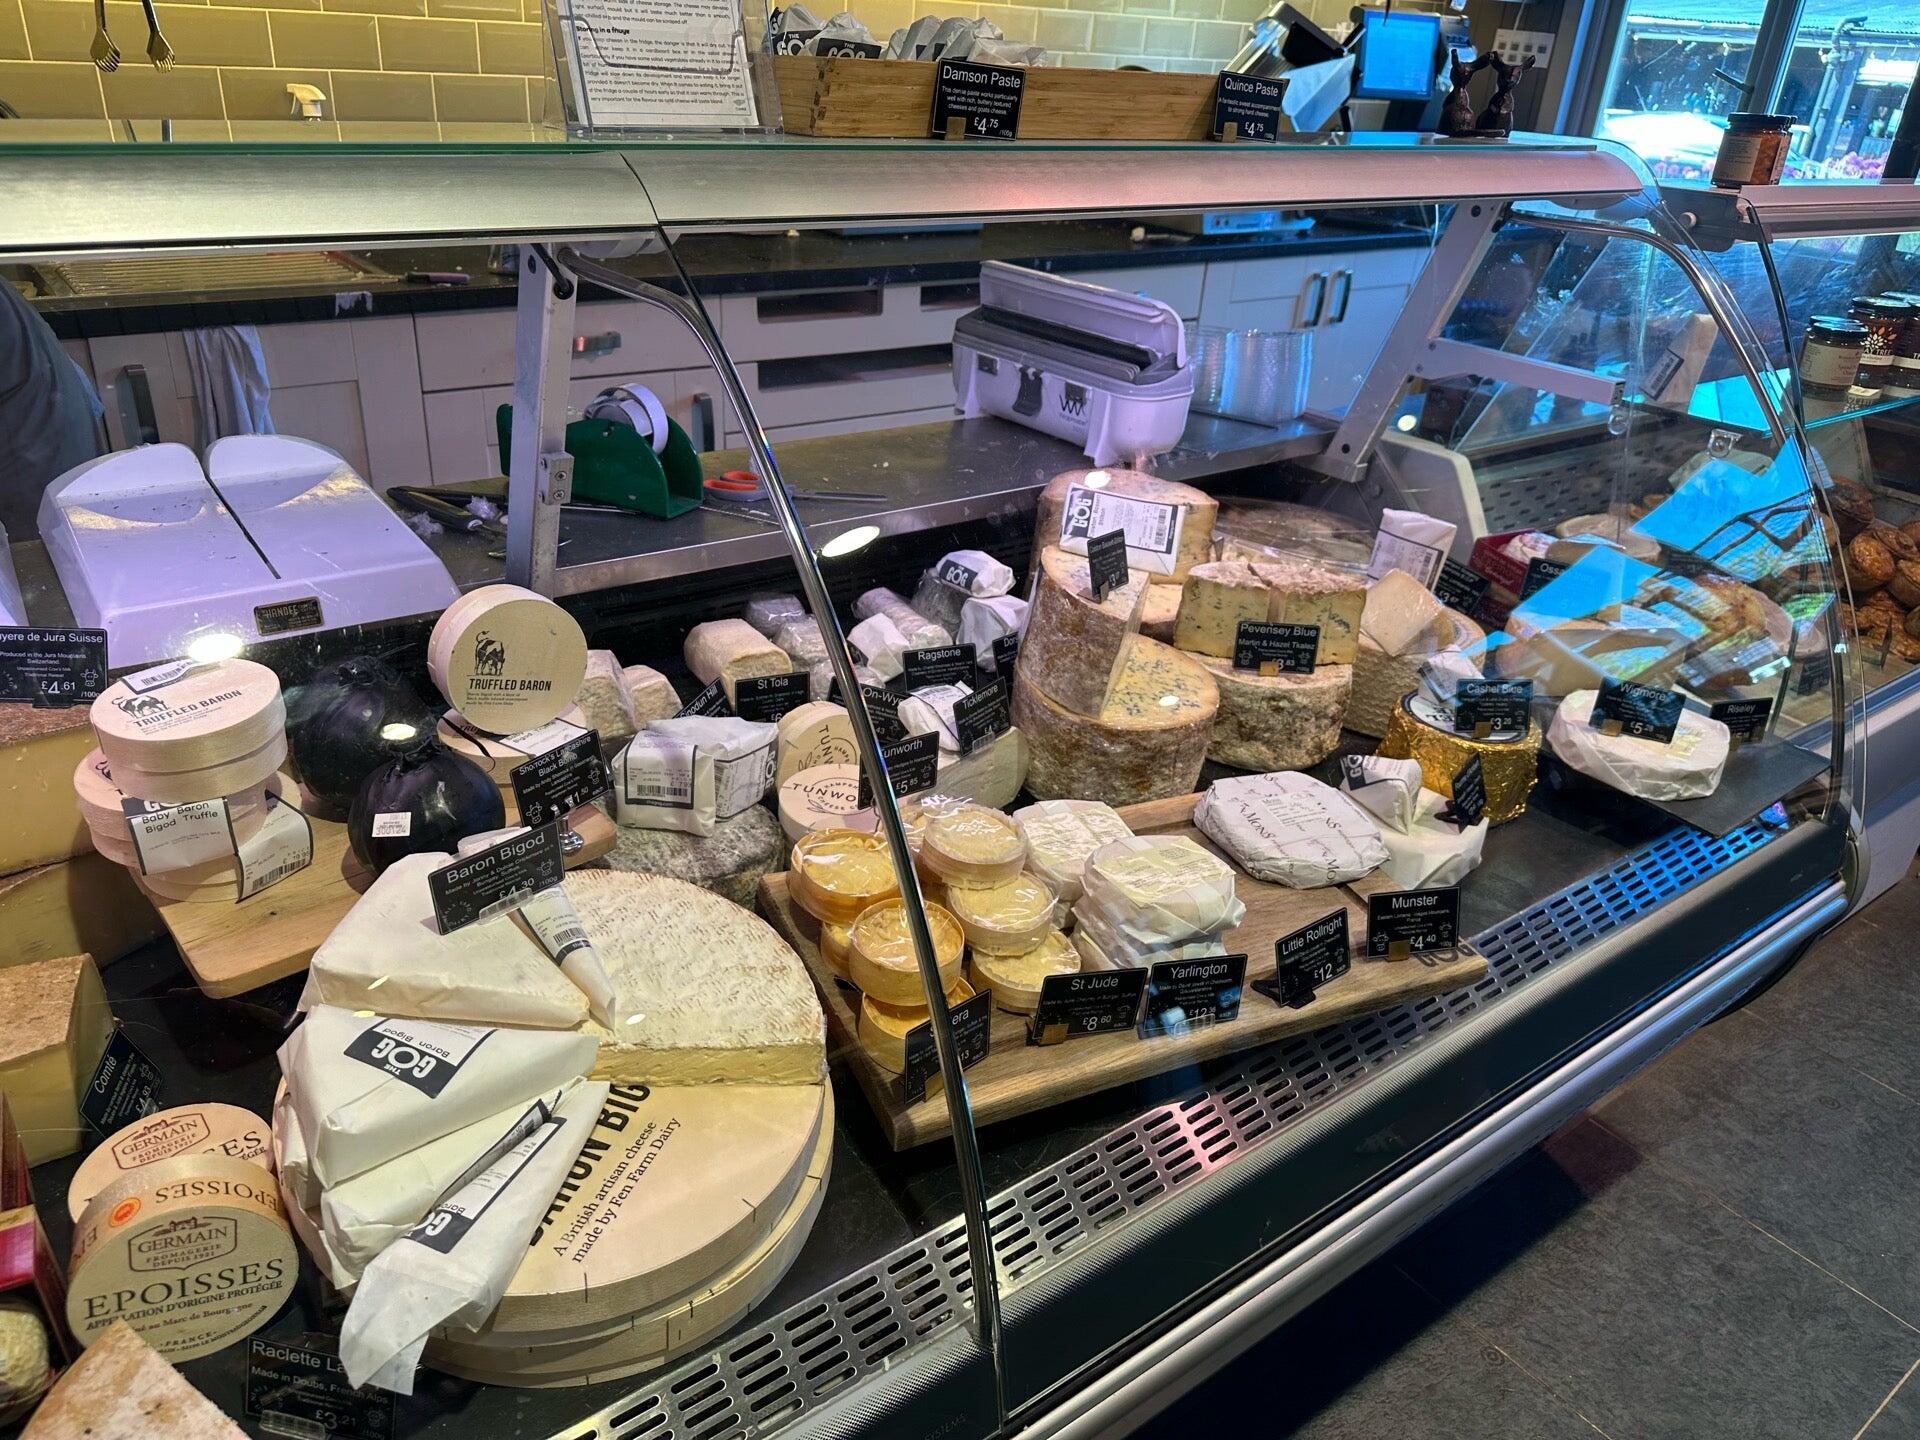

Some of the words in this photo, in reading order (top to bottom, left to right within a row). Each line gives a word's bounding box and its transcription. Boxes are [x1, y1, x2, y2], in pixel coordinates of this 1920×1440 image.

[943, 65, 988, 84] Damson
[990, 72, 1020, 88] Paste
[1224, 78, 1254, 92] Quince
[1256, 82, 1278, 97] Paste
[974, 116, 998, 134] £4.75
[946, 566, 968, 588] GOG
[27, 632, 40, 641] de
[43, 632, 66, 642] Jura
[68, 633, 102, 642] Suisse
[1240, 623, 1291, 637] Pevensey
[1294, 626, 1316, 637] Blue
[918, 648, 961, 661] Ragstone
[42, 680, 76, 694] £4.61
[468, 678, 518, 691] TRUFFLED
[520, 680, 552, 691] BARON
[706, 684, 718, 700] Hill
[758, 680, 768, 690] St
[770, 678, 789, 688] Tola
[1466, 683, 1499, 694] Cashel
[1620, 683, 1666, 701] Wigmore
[962, 684, 998, 710] Ticklemore
[134, 703, 198, 728] TRUFFLED
[198, 690, 242, 708] BARON
[538, 763, 558, 777] Black
[142, 810, 170, 825] Baby
[177, 802, 210, 814] Baron
[145, 819, 177, 834] Bigod
[183, 810, 219, 822] Truffle
[446, 855, 496, 884] Baron
[500, 832, 545, 860] Bigod
[1392, 895, 1438, 909] Munster
[1282, 936, 1305, 956] Little
[1306, 917, 1343, 942] Rollright
[1410, 934, 1436, 949] £4.40
[1171, 964, 1228, 979] Yarlington
[1314, 962, 1333, 982] £12
[1071, 980, 1085, 991] St
[1088, 976, 1119, 989] Jude
[1082, 1015, 1112, 1031] £8.60
[382, 1026, 415, 1044] Bigod
[371, 1037, 438, 1078] GOG
[418, 1040, 450, 1058] Baron
[94, 1054, 116, 1094] Comté
[384, 1062, 401, 1076] THE
[122, 1119, 198, 1157] GERMAIN
[132, 1132, 197, 1162] FROMAGERIE
[139, 1146, 173, 1164] DEPUIS
[155, 1180, 277, 1212] EPOISSES
[552, 1244, 567, 1258] A
[560, 1198, 600, 1244] British
[594, 1158, 633, 1203] artisan
[624, 1120, 658, 1161] cheese
[571, 1224, 604, 1264] made
[596, 1204, 619, 1231] by
[610, 1181, 634, 1212] Fen
[626, 1150, 660, 1185] Farm
[650, 1116, 682, 1156] Dairy
[137, 1226, 228, 1253] GERMAIN
[146, 1244, 222, 1264] FROMAGERIE
[152, 1256, 191, 1268] DEPUIS
[84, 1258, 284, 1320] EPOISSES
[166, 1291, 226, 1315] D'ORIGINE
[227, 1280, 283, 1299] PROTÉGÉE
[163, 1314, 187, 1327] Marc
[190, 1311, 201, 1320] de
[252, 1340, 321, 1368] Raclette
[251, 1366, 279, 1380] Made
[282, 1374, 290, 1382] in
